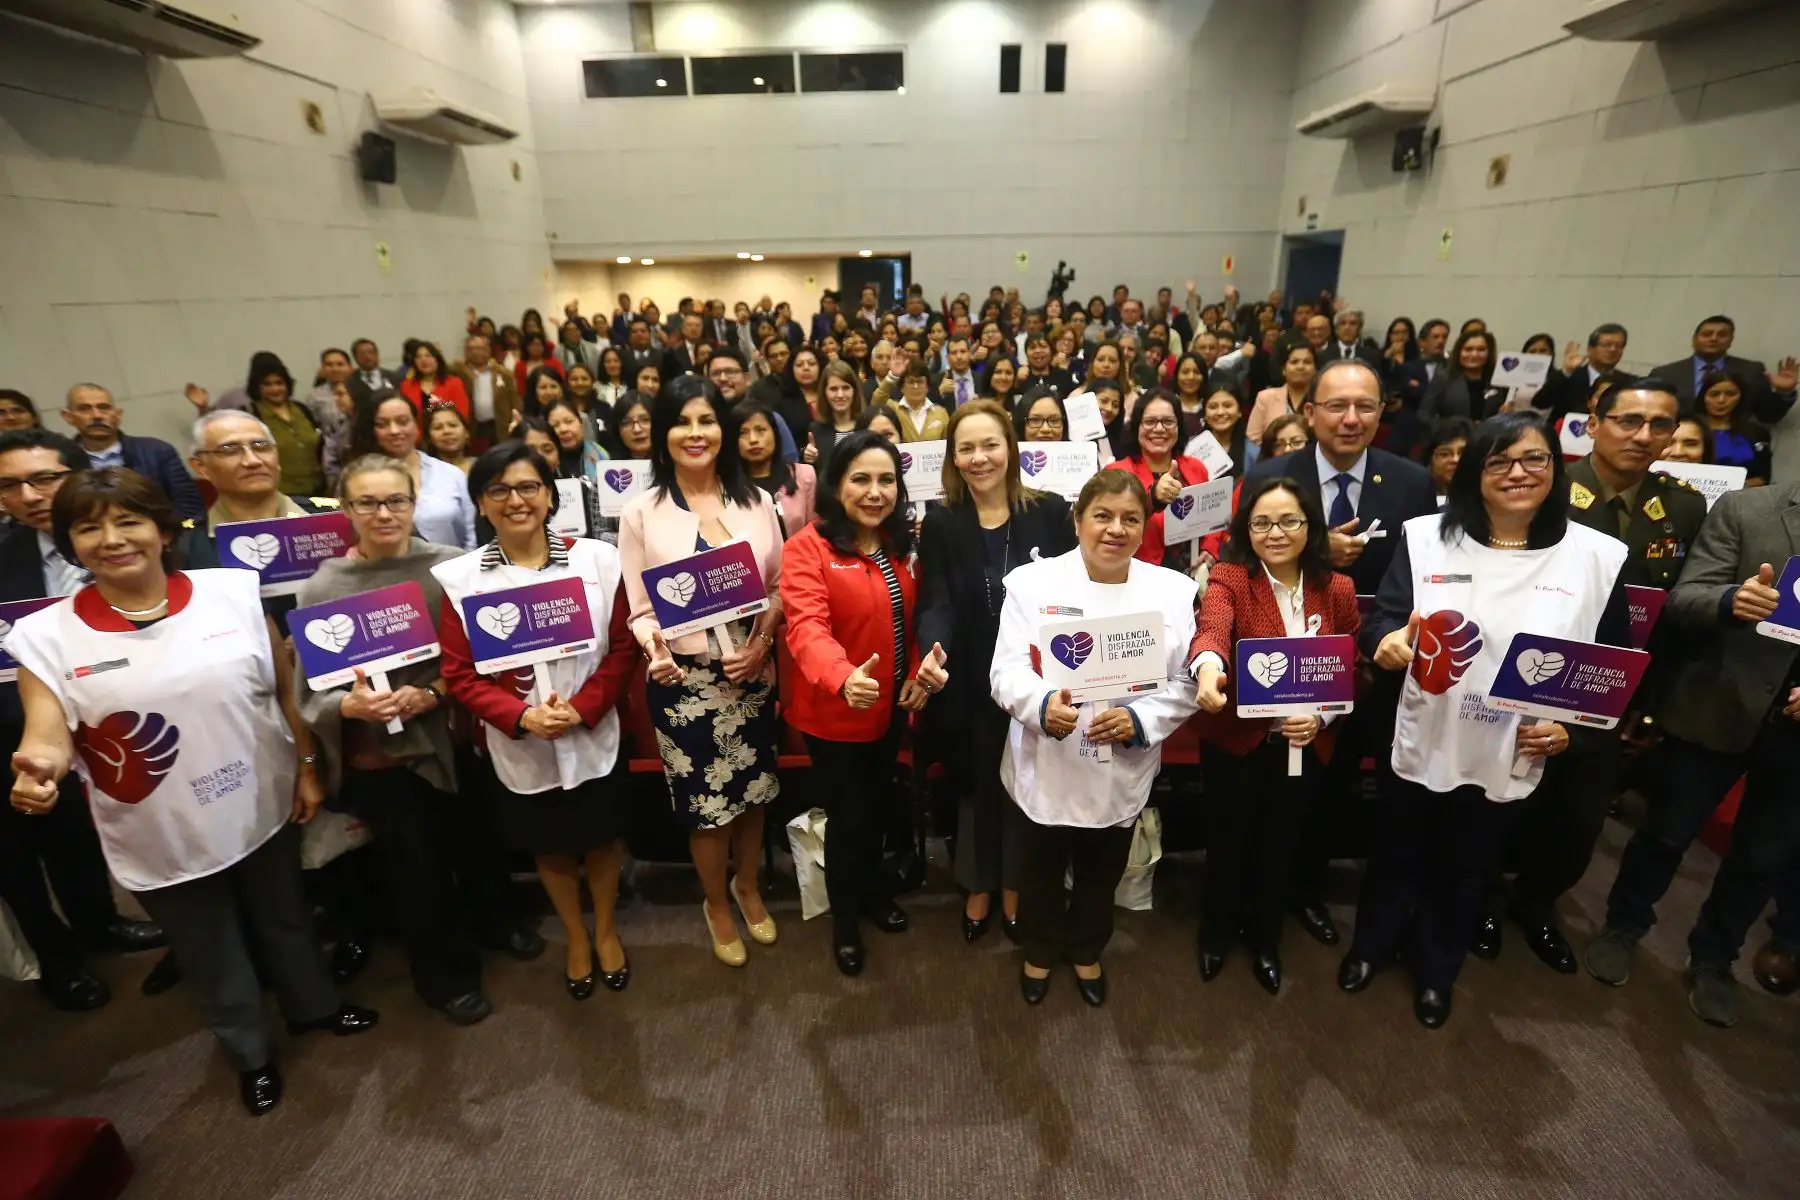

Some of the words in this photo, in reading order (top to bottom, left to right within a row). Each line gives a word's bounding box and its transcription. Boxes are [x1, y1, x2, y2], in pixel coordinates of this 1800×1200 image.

[292, 531, 339, 543] VIOLENCIA
[296, 552, 308, 561] DE
[309, 548, 335, 559] AMOR
[705, 561, 745, 578] VIOLENCIA
[708, 567, 751, 585] DISFRAZADA
[710, 585, 721, 594] DE
[722, 578, 743, 590] AMOR
[365, 602, 413, 621] VIOLENCIA
[531, 596, 575, 612] VIOLENCIA
[368, 609, 421, 629] DISFRAZADA
[533, 605, 581, 620] DISFRAZADA
[535, 620, 546, 629] DE
[548, 614, 571, 626] AMOR
[371, 629, 383, 639] DE
[386, 621, 411, 635] AMOR
[1106, 629, 1150, 642] VIOLENCIA
[1107, 638, 1156, 652] DISFRAZADA
[1108, 651, 1118, 660] DE
[1121, 648, 1144, 659] AMOR
[1300, 656, 1341, 666] VIOLENCIA
[1300, 664, 1346, 674] DISFRAZADA
[1578, 663, 1625, 679] VIOLENCIA
[1300, 674, 1310, 683] DE
[1312, 673, 1334, 682] AMOR
[1574, 672, 1627, 689] DISFRAZADA
[1569, 680, 1581, 690] DE
[1583, 683, 1610, 694] AMOR
[1459, 711, 1471, 720] DE
[1079, 748, 1090, 757] DE
[188, 759, 244, 788] VIOLENCIA
[198, 794, 212, 806] DE
[215, 780, 244, 799] AMOR
